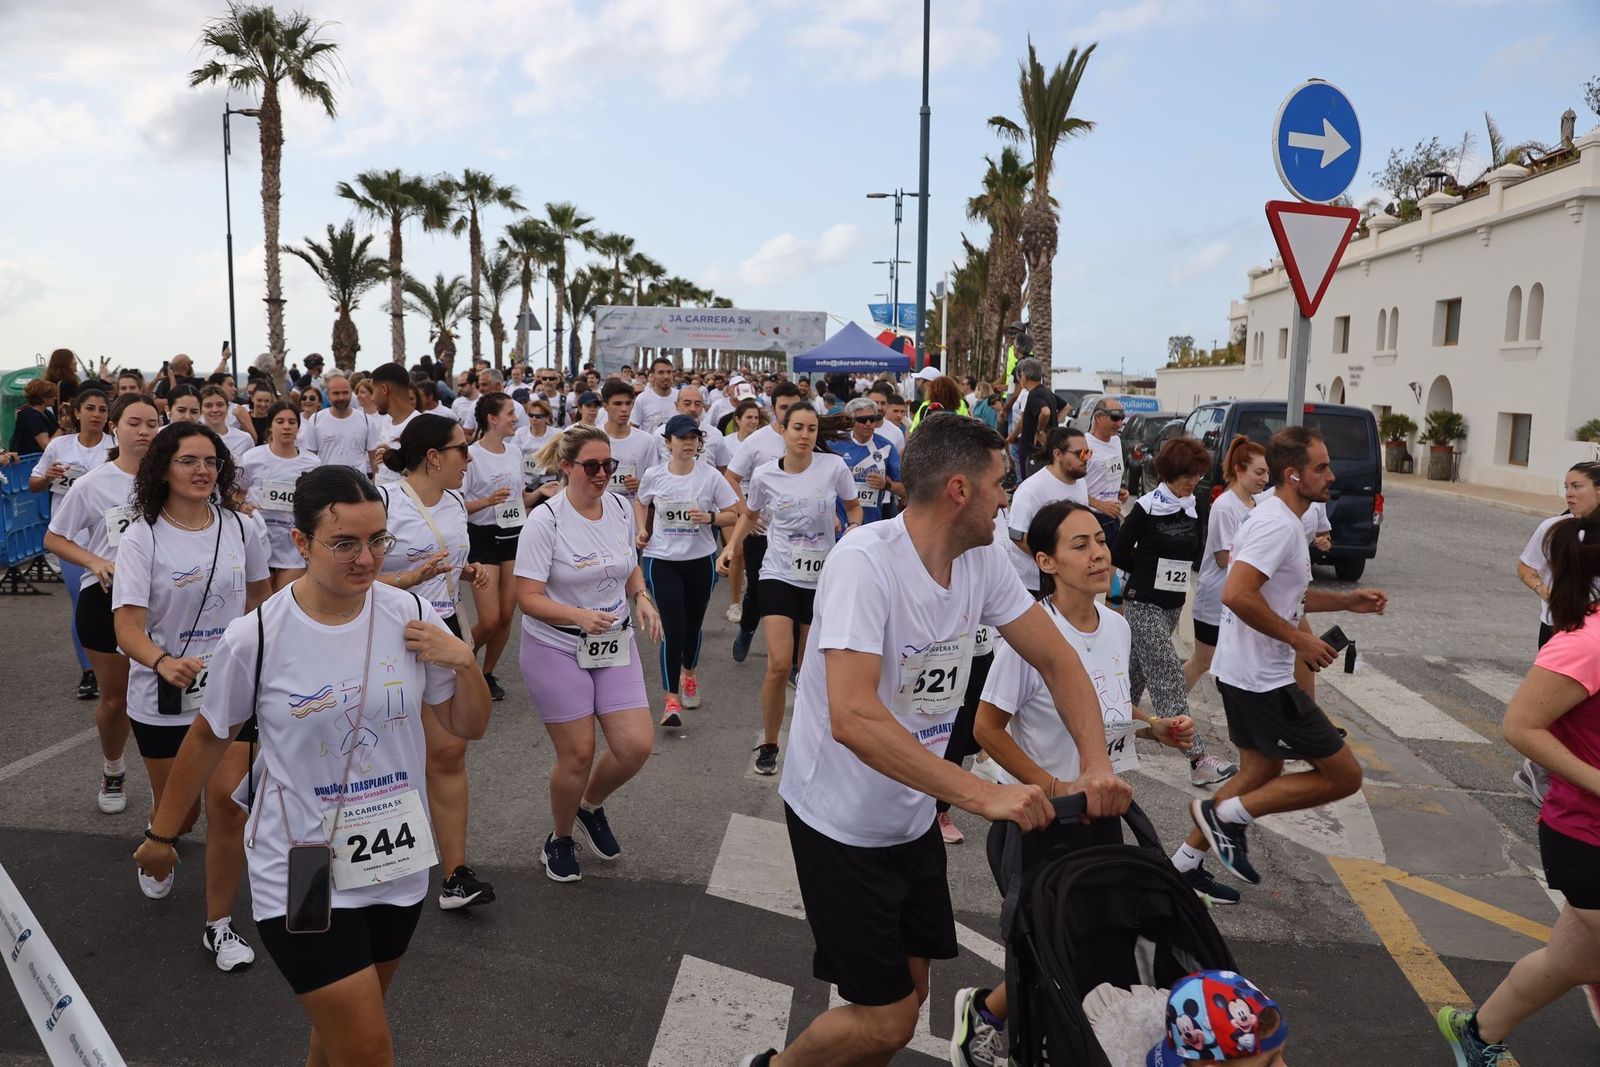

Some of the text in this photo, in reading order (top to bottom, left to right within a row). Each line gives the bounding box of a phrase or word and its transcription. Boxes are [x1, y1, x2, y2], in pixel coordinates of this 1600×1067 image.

[669, 314, 751, 325] 3A CARRERA 5K
[816, 360, 888, 368] info@dorsalchip.es
[857, 491, 874, 500] 67
[502, 508, 520, 519] 446
[1165, 570, 1187, 583] 122
[588, 639, 619, 656] 876
[350, 774, 394, 793] TRASPLANTE
[363, 787, 388, 799] Granados
[388, 782, 409, 793] Cabezas
[343, 809, 354, 818] 3A
[355, 802, 394, 816] CARRERA
[347, 822, 416, 864] 244
